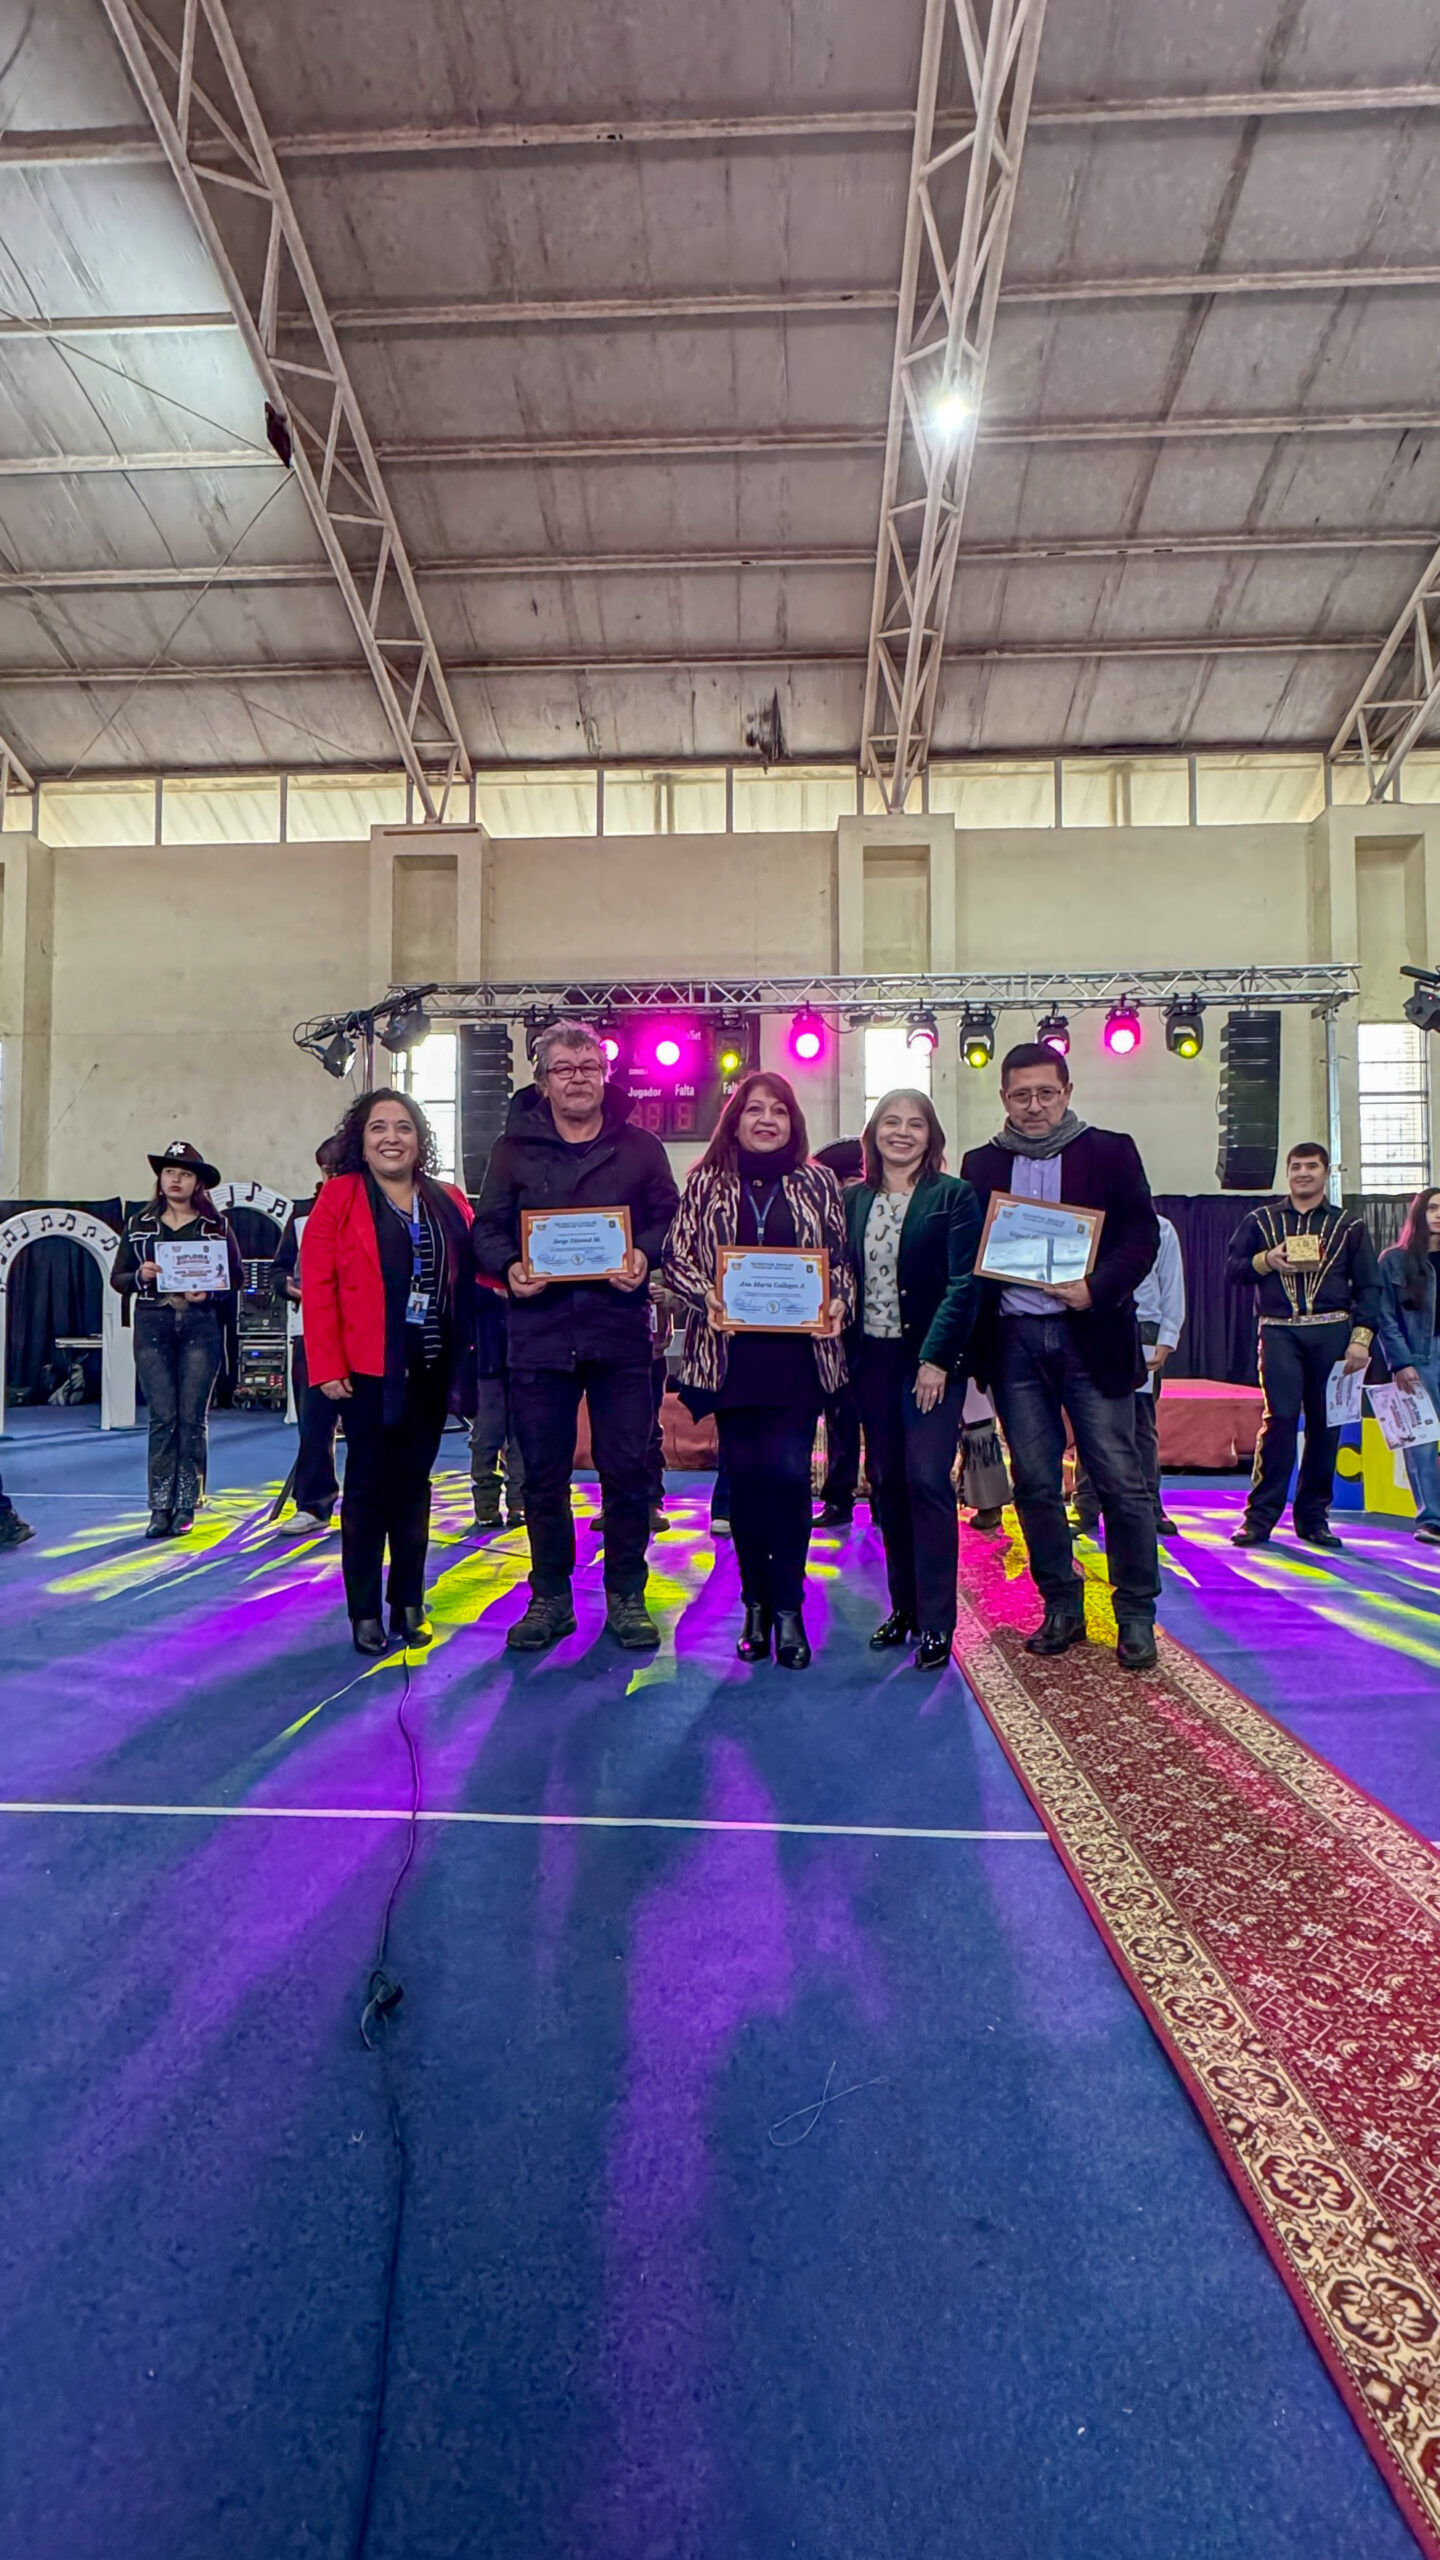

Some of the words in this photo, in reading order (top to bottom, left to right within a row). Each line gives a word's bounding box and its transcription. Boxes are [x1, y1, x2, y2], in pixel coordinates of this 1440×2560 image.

[627, 1086, 662, 1099] Jugador
[675, 1084, 695, 1096] Falta
[723, 1082, 739, 1095] Falt
